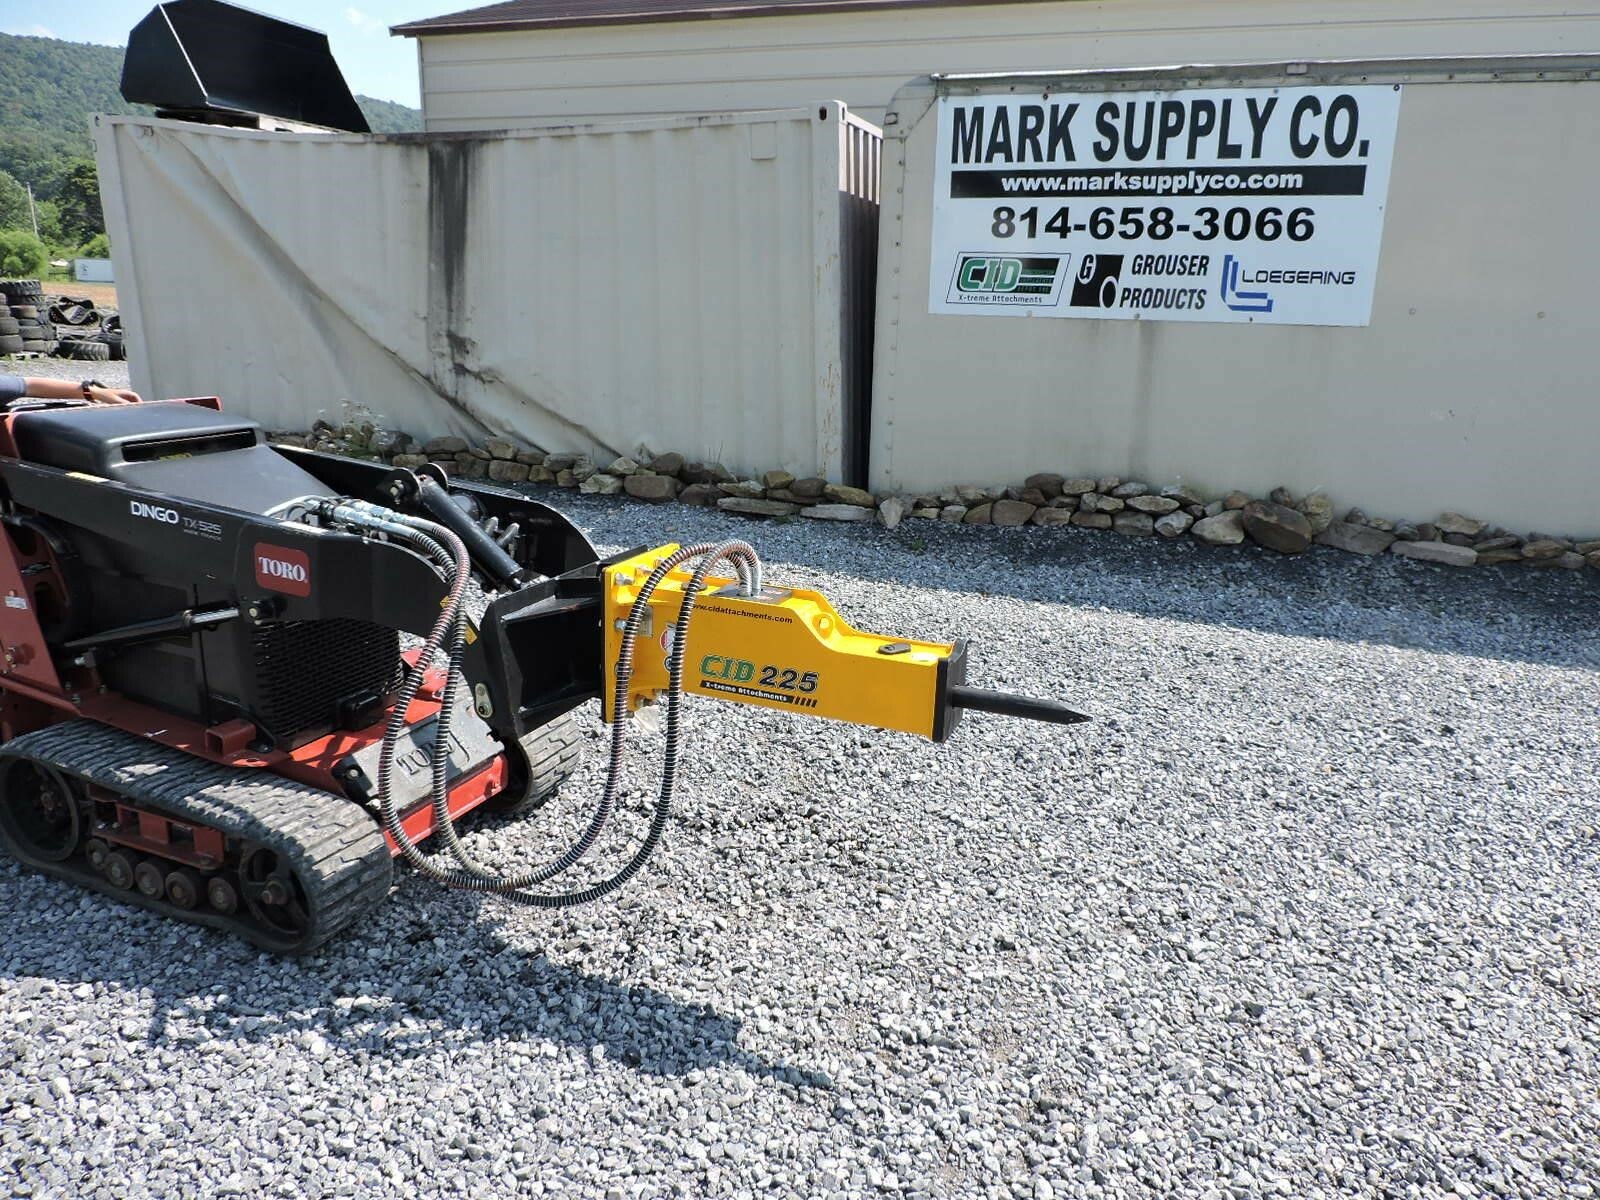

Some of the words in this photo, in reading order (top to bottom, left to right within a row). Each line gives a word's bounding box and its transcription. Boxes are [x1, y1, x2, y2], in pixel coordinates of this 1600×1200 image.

[951, 103, 1080, 164] MARK
[1093, 97, 1279, 162] SUPPLY
[1289, 94, 1370, 159] CO.
[1001, 170, 1303, 194] www.marksupplyco.com
[991, 206, 1316, 242] 814-658-3066
[960, 258, 1022, 292] CID
[1132, 254, 1210, 276] GROUSER
[1242, 270, 1356, 285] LOEGERING
[992, 294, 1042, 303] Attachments
[1120, 288, 1207, 310] PRODUCTS
[130, 500, 179, 524] DINGO
[258, 556, 306, 582] TORO
[700, 654, 756, 682] CID
[758, 664, 819, 694] 225
